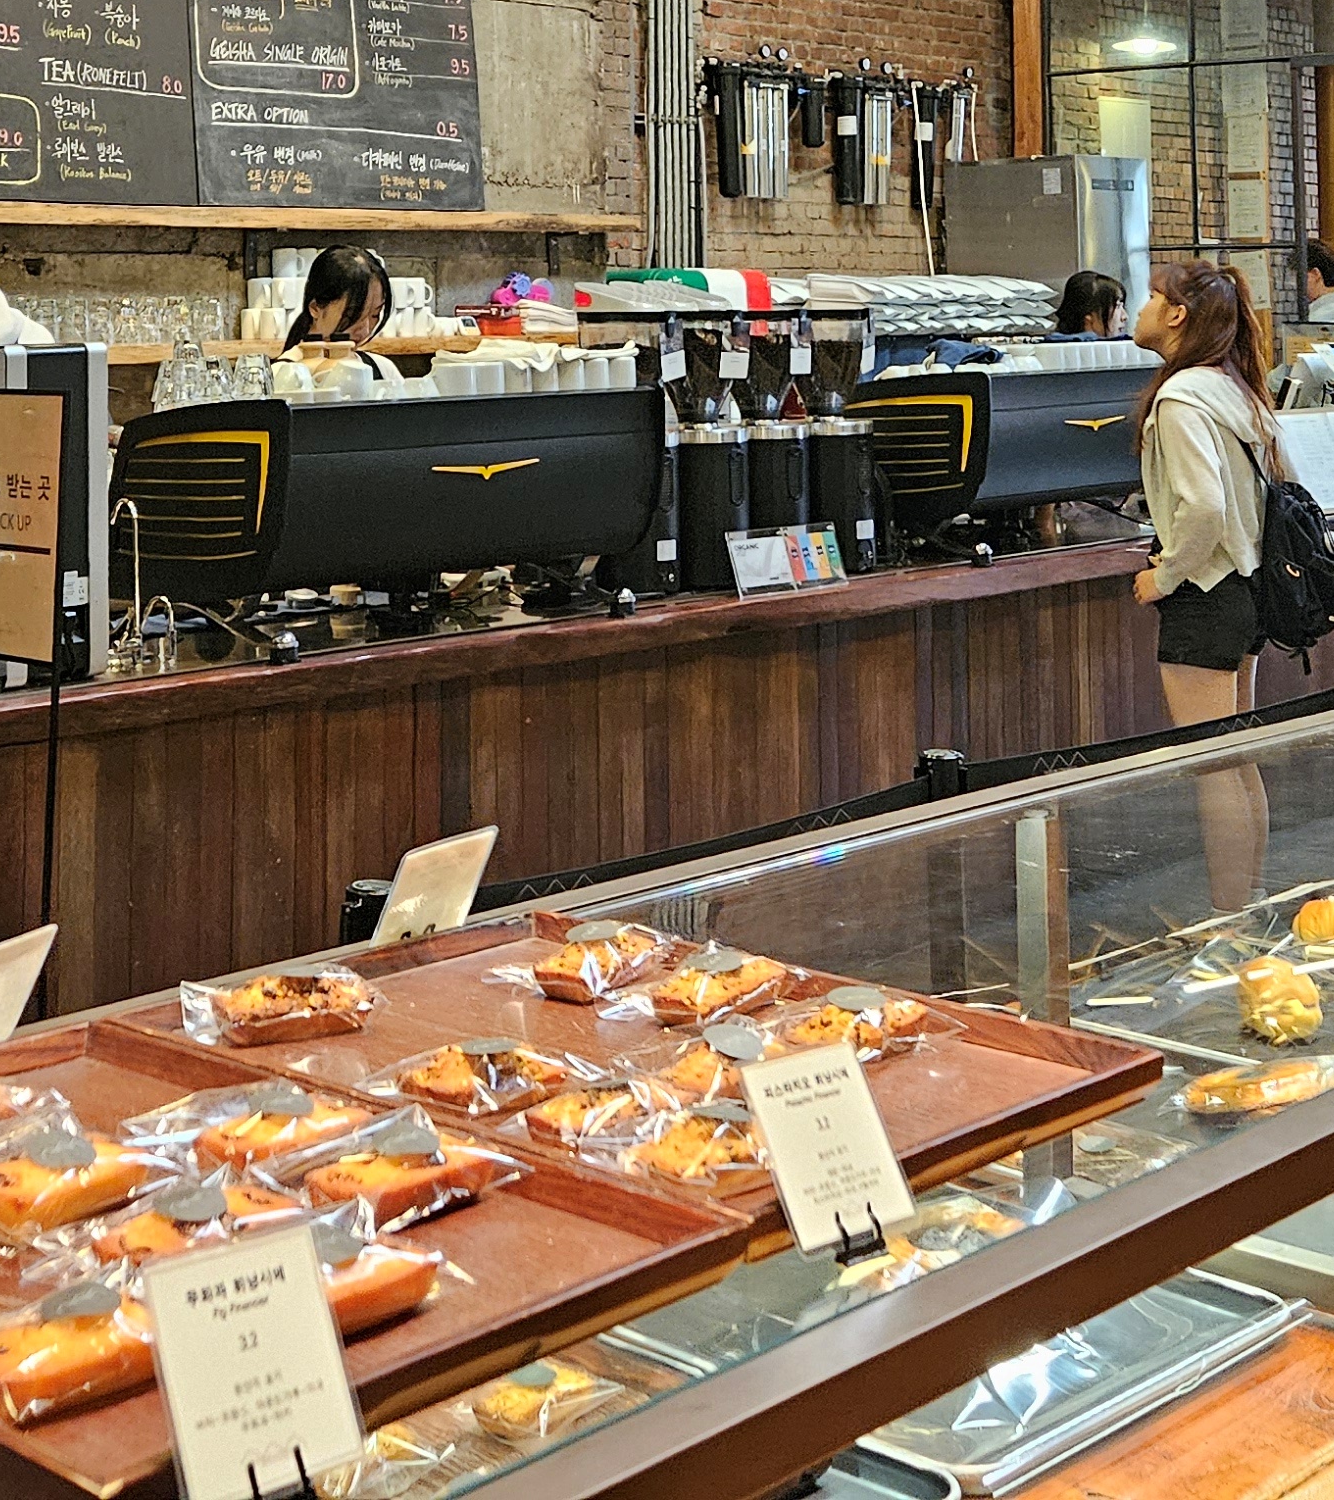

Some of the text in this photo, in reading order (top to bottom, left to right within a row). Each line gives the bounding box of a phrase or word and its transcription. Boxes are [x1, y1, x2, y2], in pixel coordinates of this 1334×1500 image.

[100, 1, 140, 30] 복숭아
[448, 25, 468, 41] 7.5
[210, 37, 348, 66] GEISHA SINGLE ORIGIN
[450, 58, 469, 75] 9.5
[162, 75, 182, 94] 8.0
[322, 71, 346, 90] 17.0
[211, 102, 309, 124] EXTRA OPTION
[437, 121, 458, 137] 0.5
[240, 144, 267, 164] 우유
[7, 474, 32, 499] 받는
[38, 476, 51, 500] 곳
[17, 515, 31, 531] UP
